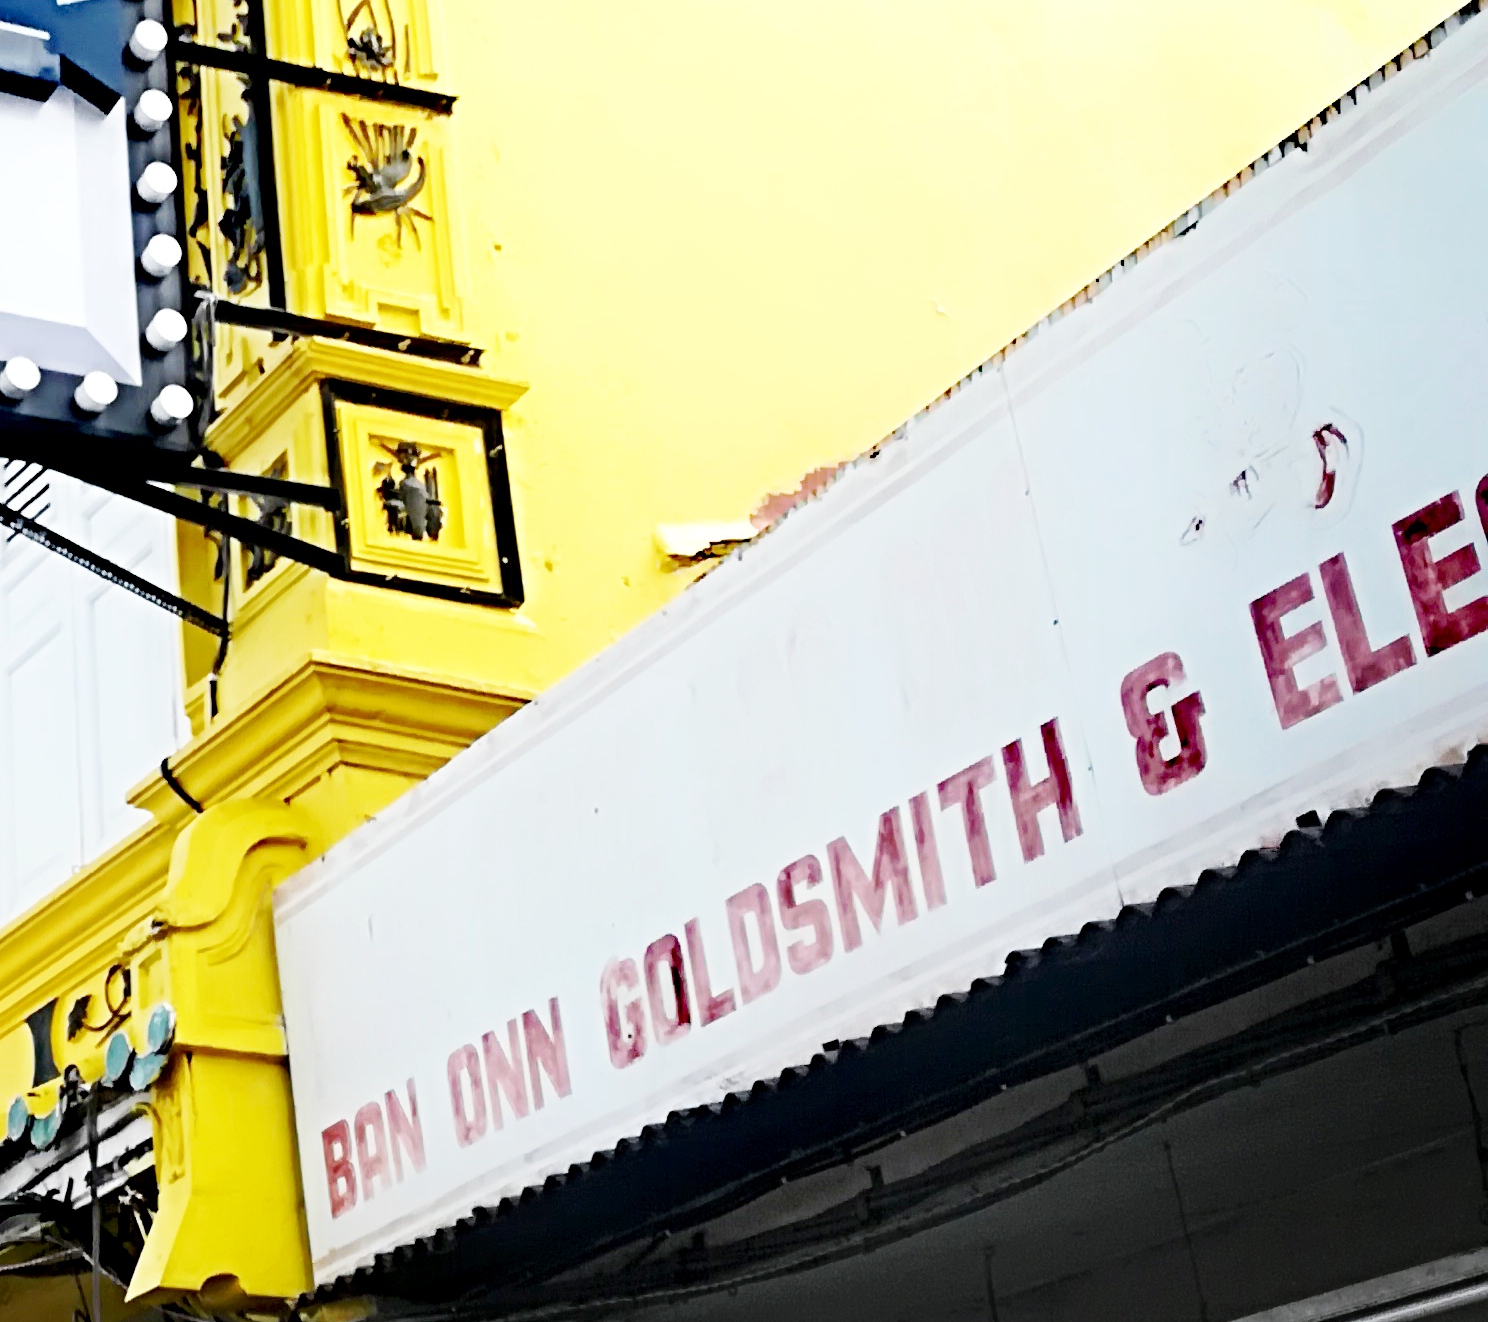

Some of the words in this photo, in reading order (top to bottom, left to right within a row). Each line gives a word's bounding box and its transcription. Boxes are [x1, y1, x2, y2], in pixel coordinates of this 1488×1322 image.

[321, 1078, 425, 1219] BAN
[447, 996, 571, 1145] ONN
[599, 717, 1083, 1069] GOLDSMITH
[1120, 651, 1208, 797] &
[1248, 473, 1488, 730] ELE
